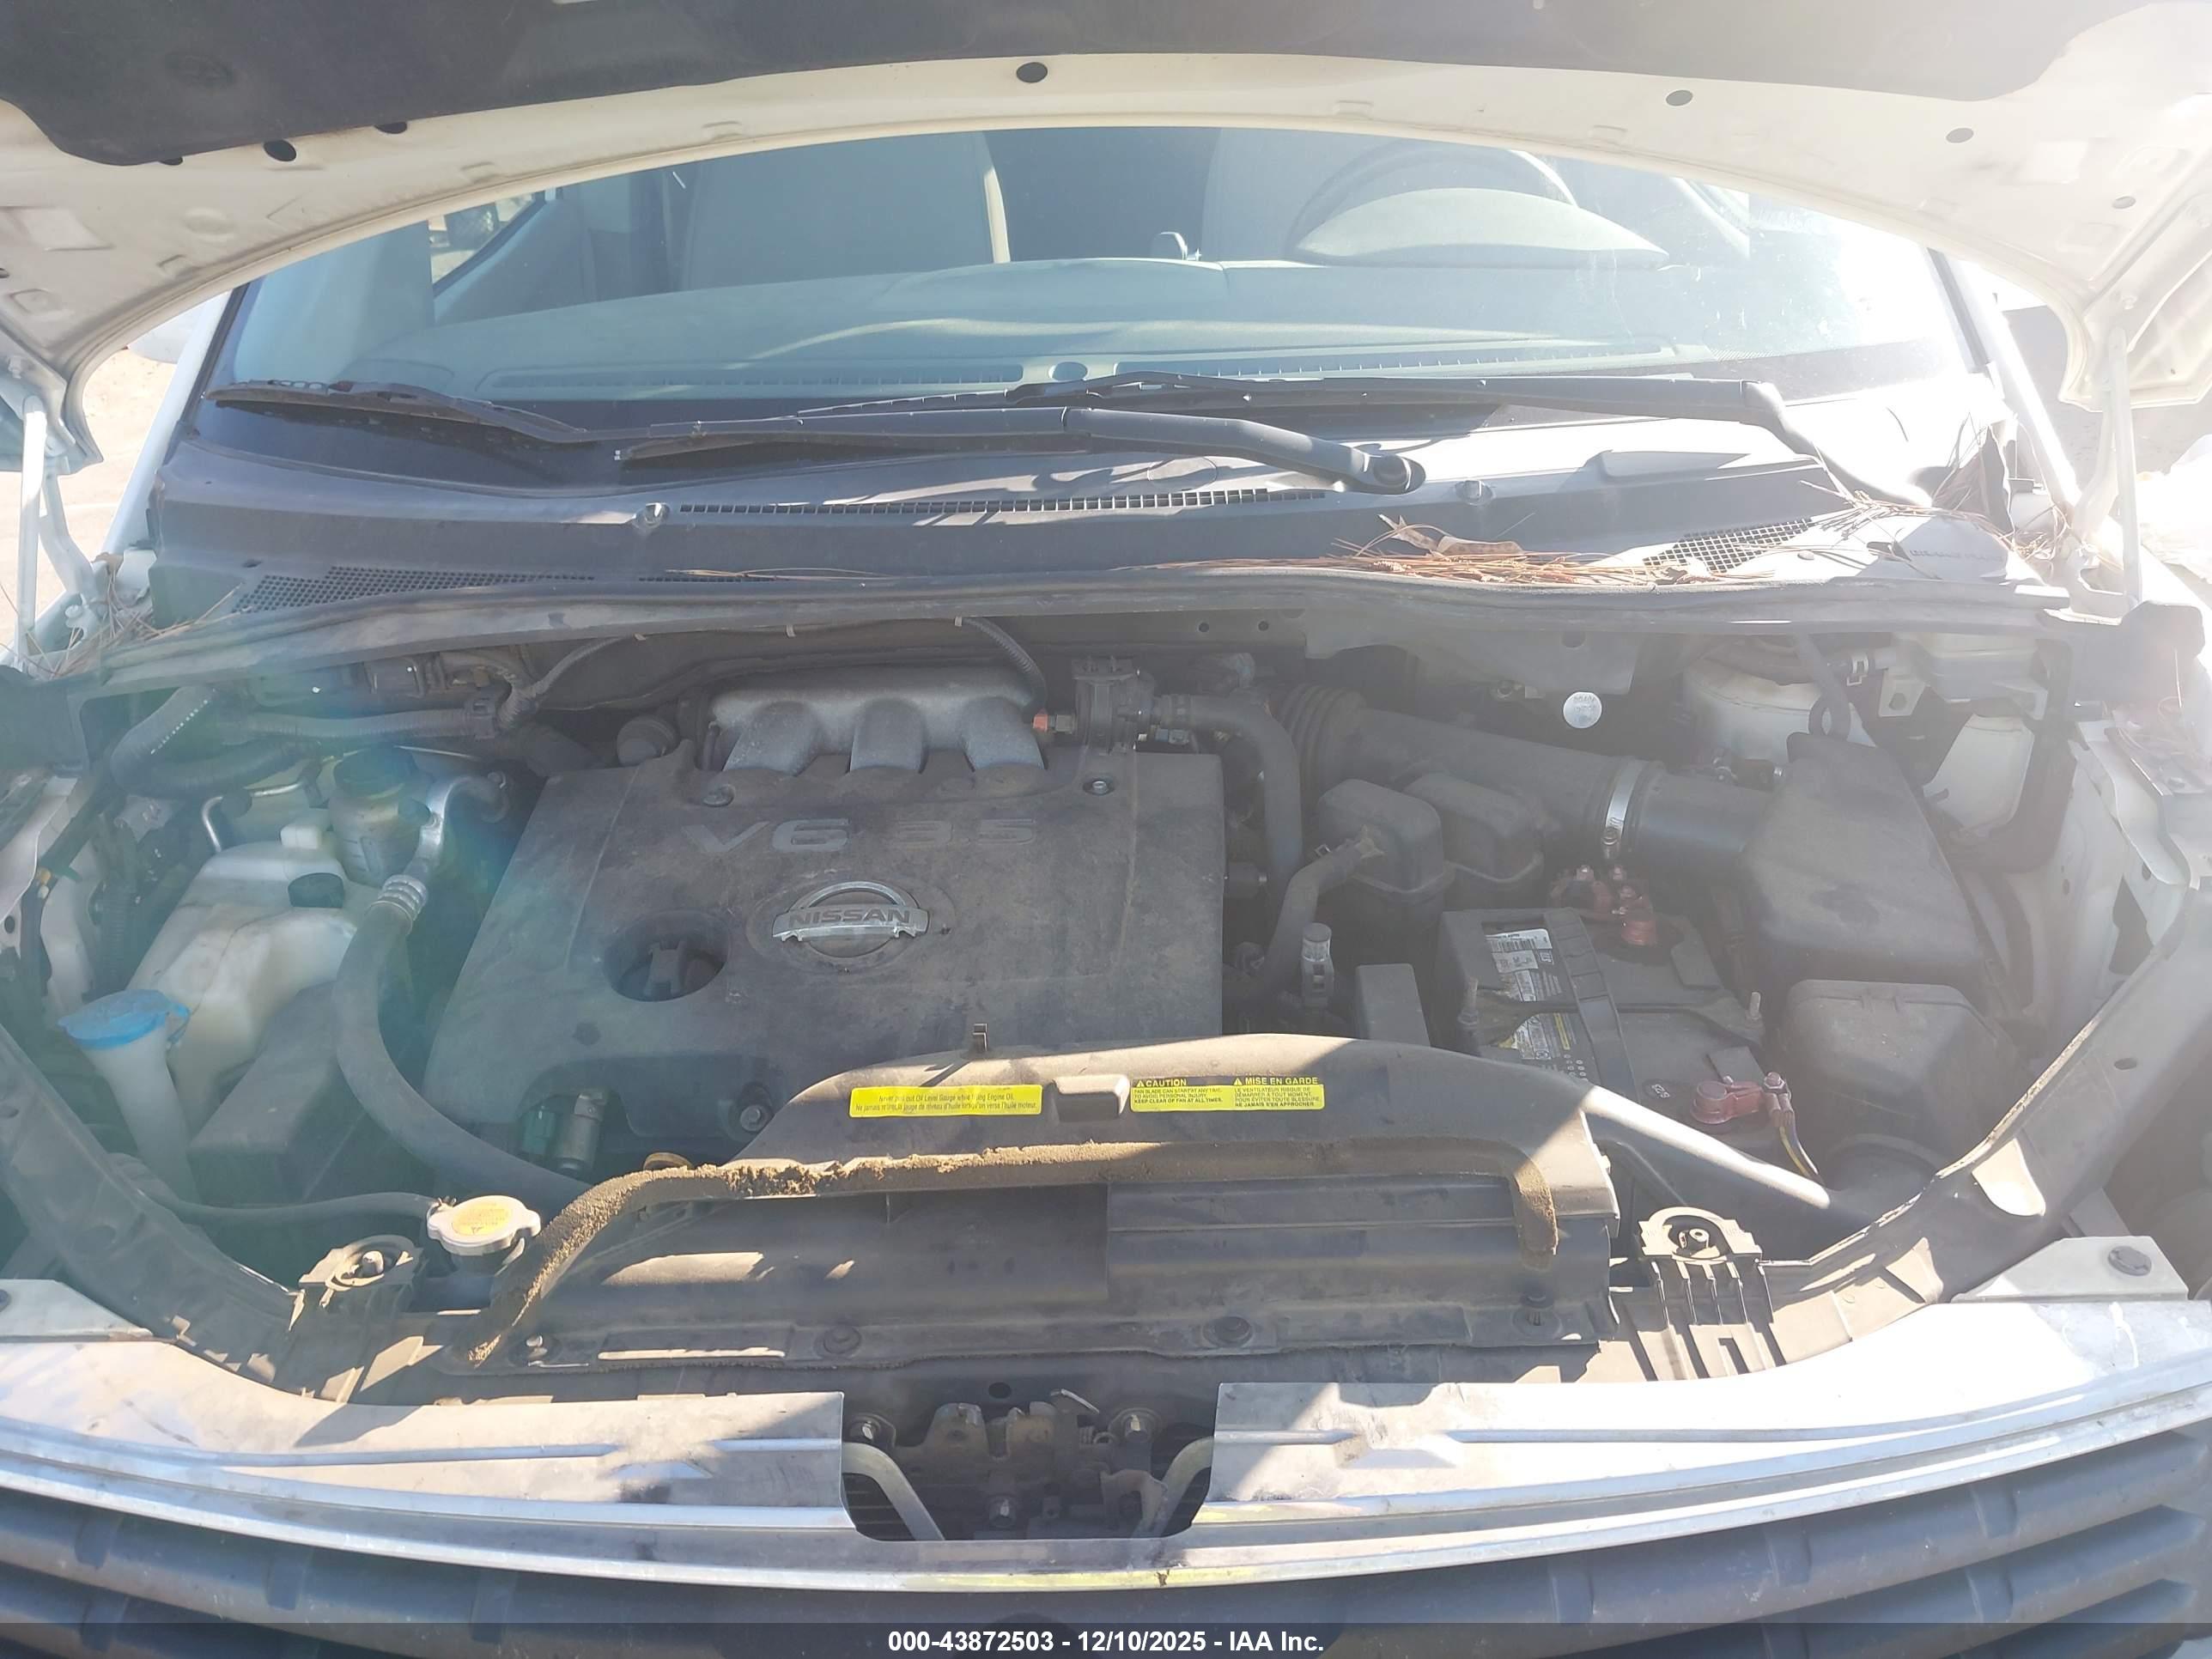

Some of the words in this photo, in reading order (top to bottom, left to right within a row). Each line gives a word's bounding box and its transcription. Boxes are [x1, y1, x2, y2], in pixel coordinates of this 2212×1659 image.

[681, 817, 849, 853] V6
[891, 817, 1036, 849] 3.5
[787, 908, 910, 927] NISSAN
[1146, 1079, 1187, 1087] CAUTION
[1245, 1077, 1267, 1085] MISE
[987, 1092, 1006, 1102] Engine
